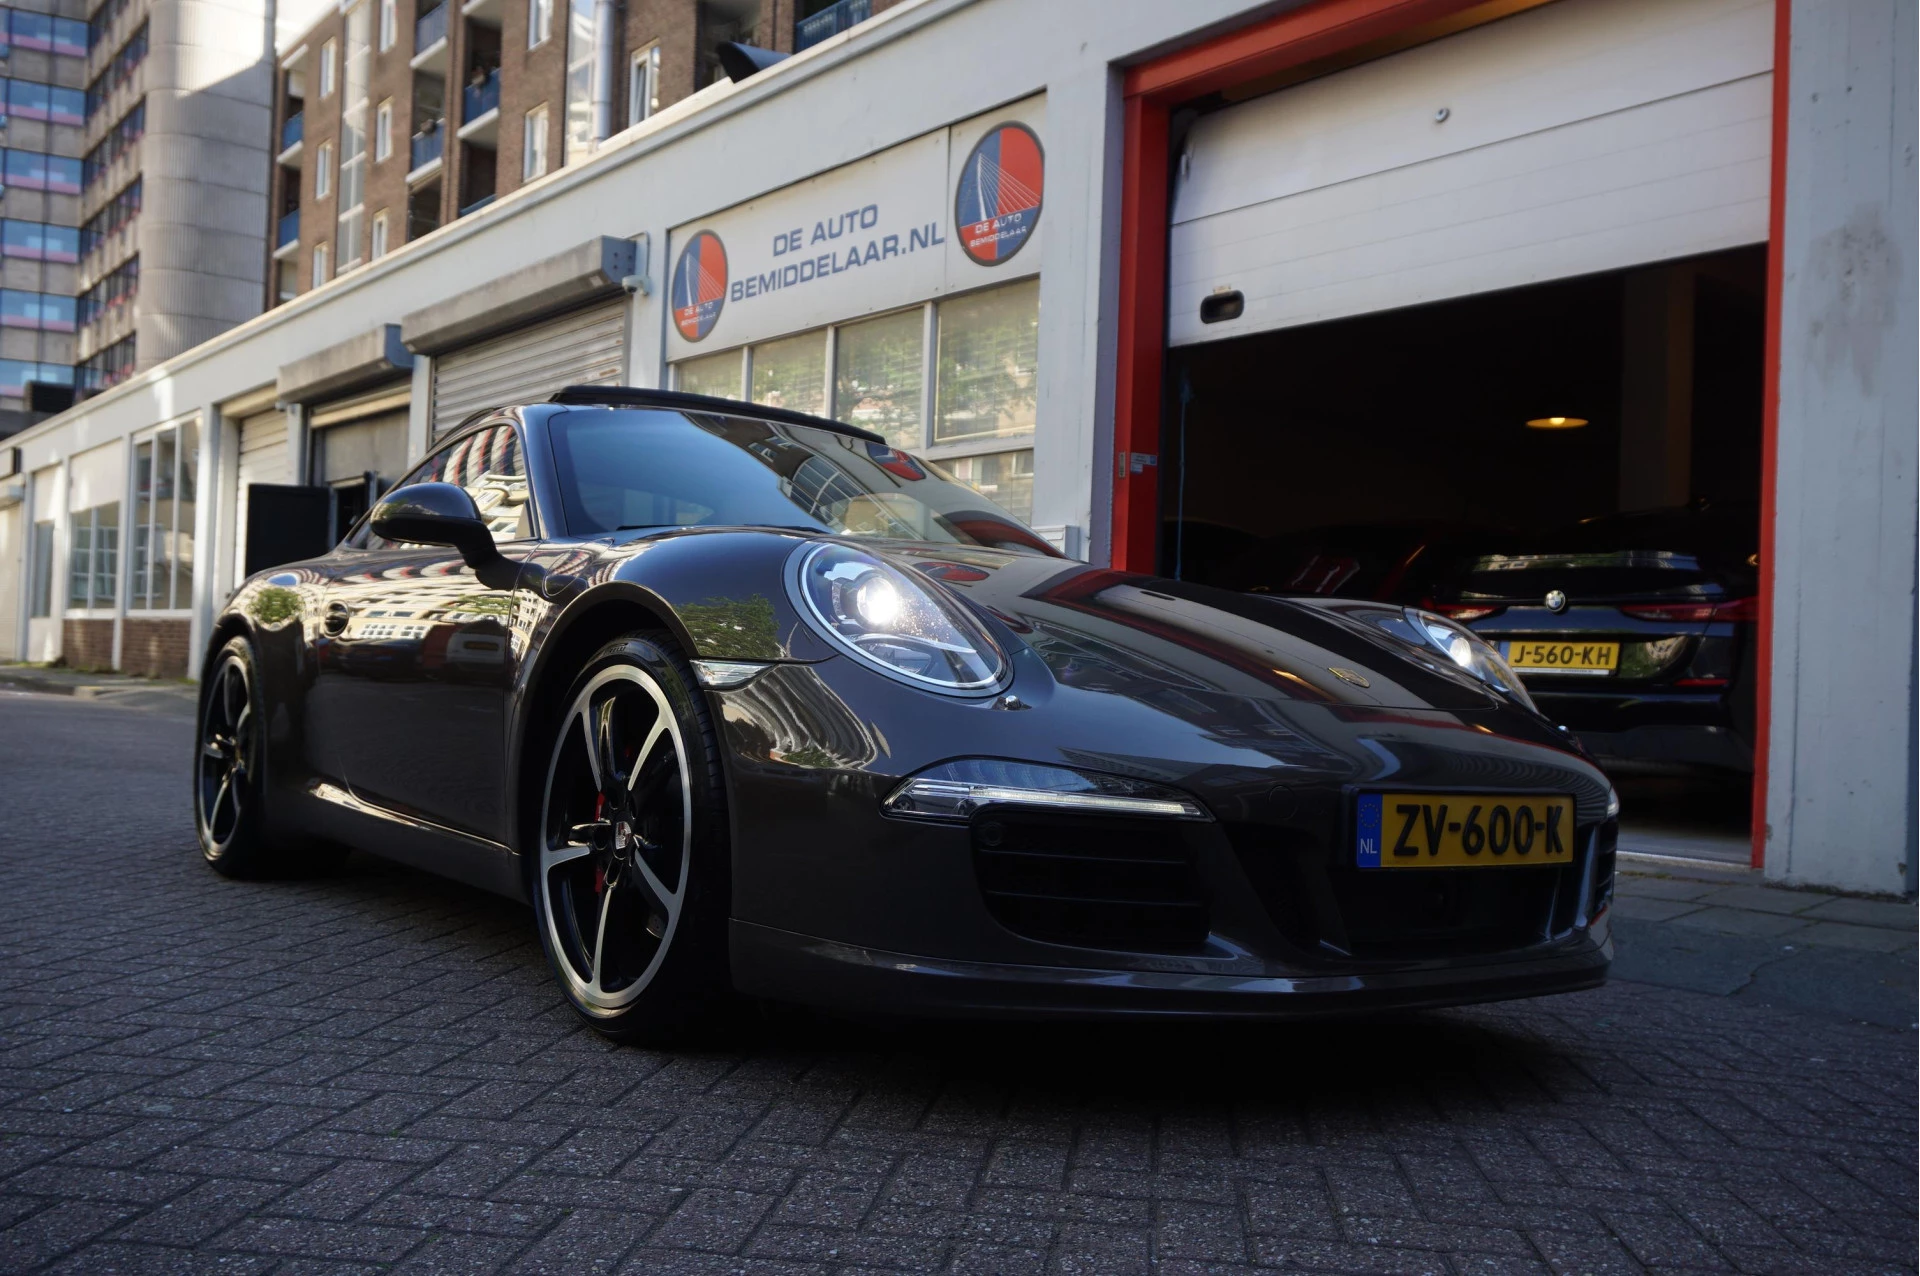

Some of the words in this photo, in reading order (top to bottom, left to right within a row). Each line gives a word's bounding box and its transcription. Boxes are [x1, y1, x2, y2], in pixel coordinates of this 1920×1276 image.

[772, 228, 803, 257] DE
[810, 203, 878, 246] AUTO
[975, 222, 990, 234] DE
[992, 213, 1022, 229] AUTO
[730, 222, 945, 302] BEMIDDELAAR.NL
[1514, 645, 1611, 665] J-560-KH
[1360, 838, 1378, 854] NL
[1393, 804, 1564, 857] ZV-600-K
